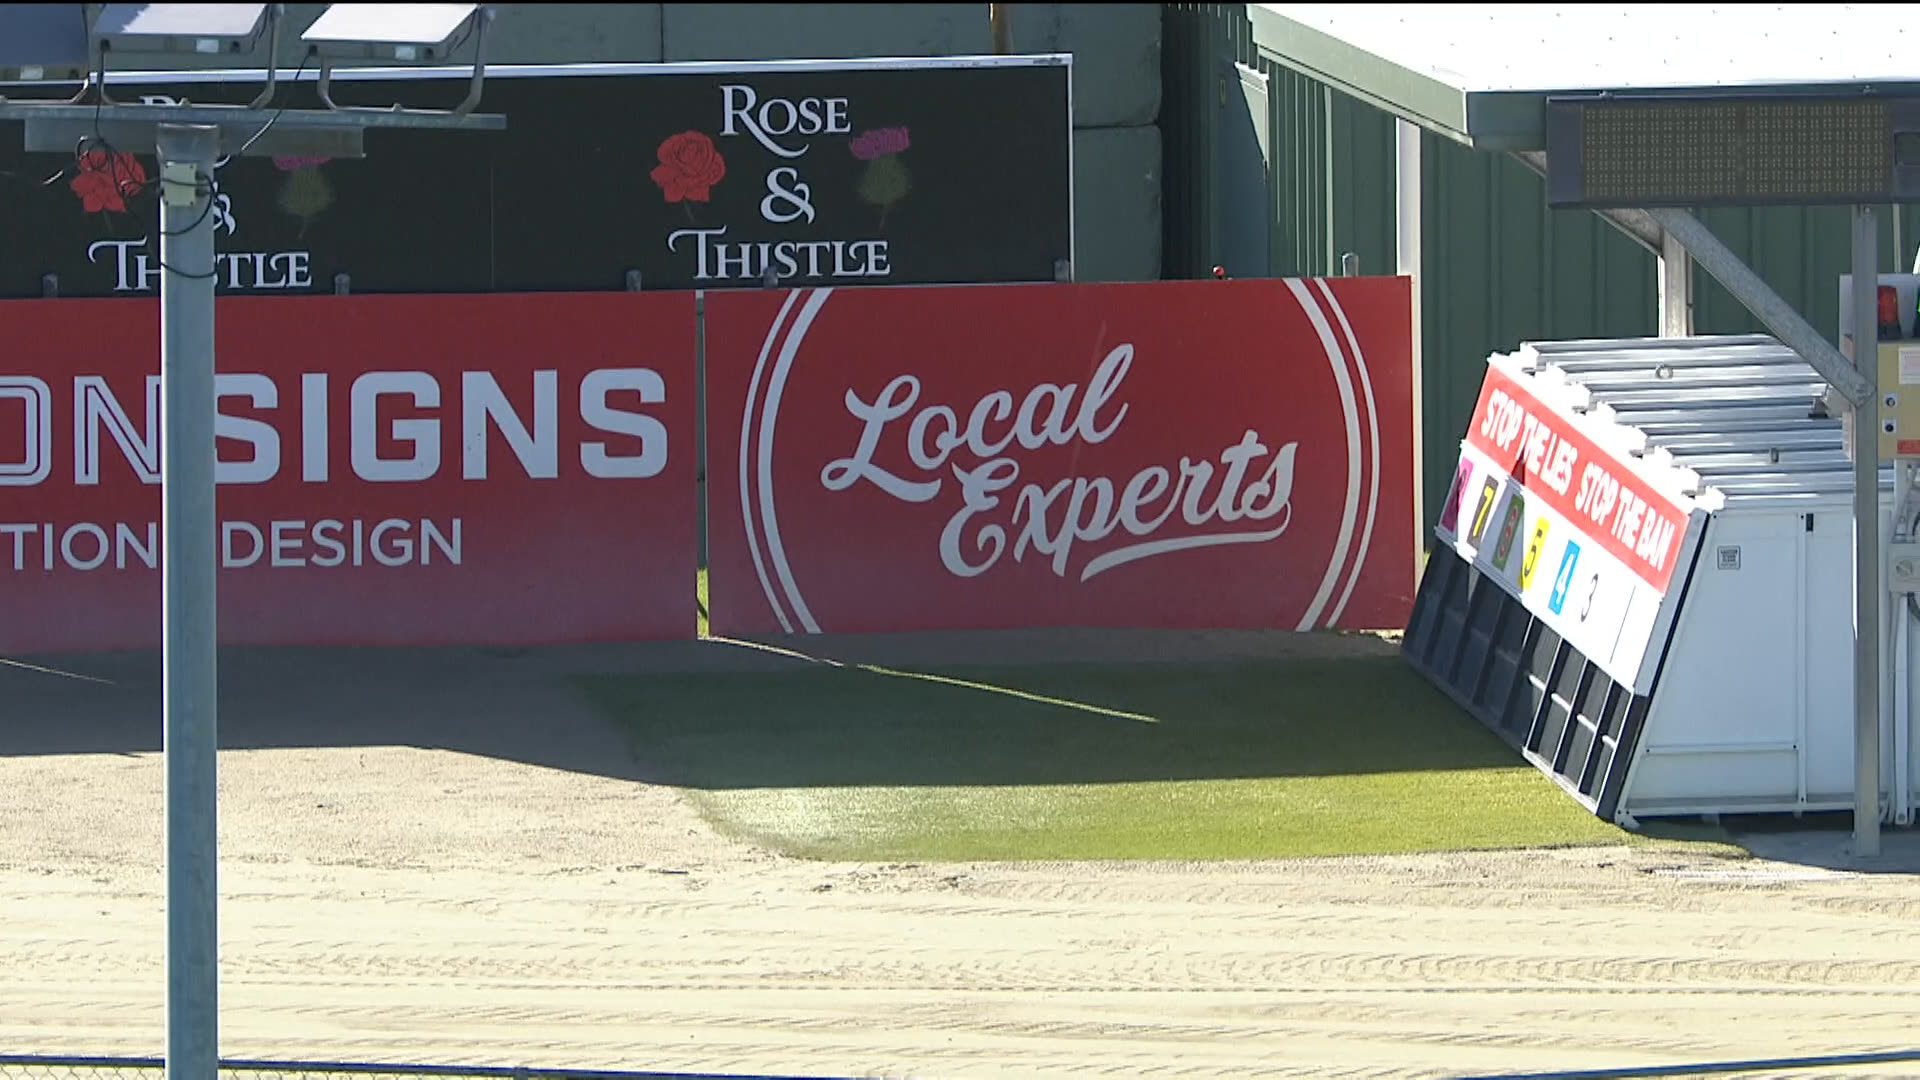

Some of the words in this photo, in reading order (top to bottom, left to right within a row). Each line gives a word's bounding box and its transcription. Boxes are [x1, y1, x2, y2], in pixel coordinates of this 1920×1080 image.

[720, 85, 851, 158] ROSE
[760, 167, 815, 224] &
[88, 236, 312, 290] THTLE
[667, 225, 891, 279] THISTLE
[820, 343, 1134, 501] Local
[939, 429, 1298, 582] Experts
[1481, 388, 1524, 453] STOP
[1515, 412, 1551, 476] THE
[1540, 433, 1578, 496] LIES
[1575, 461, 1619, 526] STOP
[1611, 485, 1647, 551] THE
[1635, 505, 1675, 573] BAN
[222, 518, 462, 568] DESIGN
[1473, 485, 1494, 537] 7
[1523, 528, 1543, 578] 5
[1556, 552, 1574, 604] 4
[1580, 573, 1598, 622] 3
